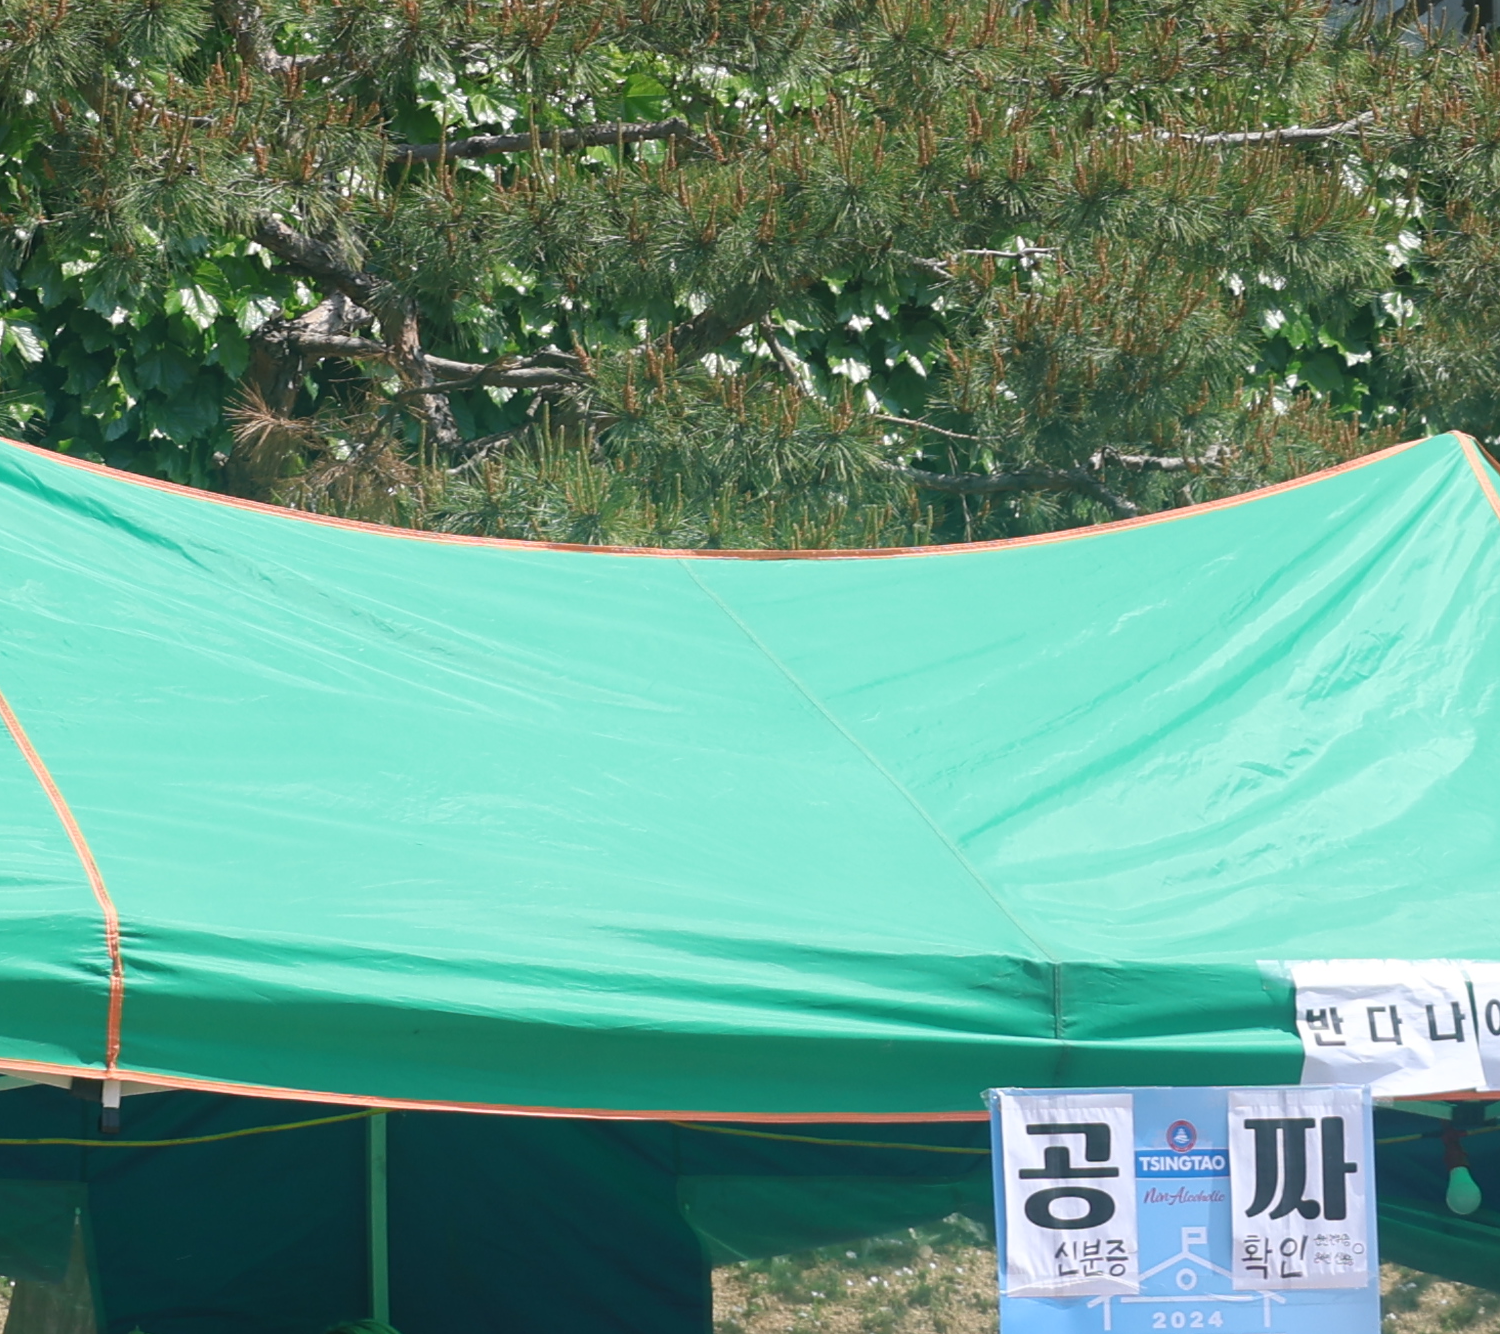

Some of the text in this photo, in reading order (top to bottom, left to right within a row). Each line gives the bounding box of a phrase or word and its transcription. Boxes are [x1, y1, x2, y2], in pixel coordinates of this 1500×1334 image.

[1019, 1123, 1119, 1230] 공
[1139, 1151, 1225, 1171] TSINGTAO
[1244, 1116, 1358, 1221] 짜
[1054, 1238, 1129, 1277] 신분증
[1241, 1234, 1308, 1279] 확인
[1152, 1311, 1223, 1329] 2024
